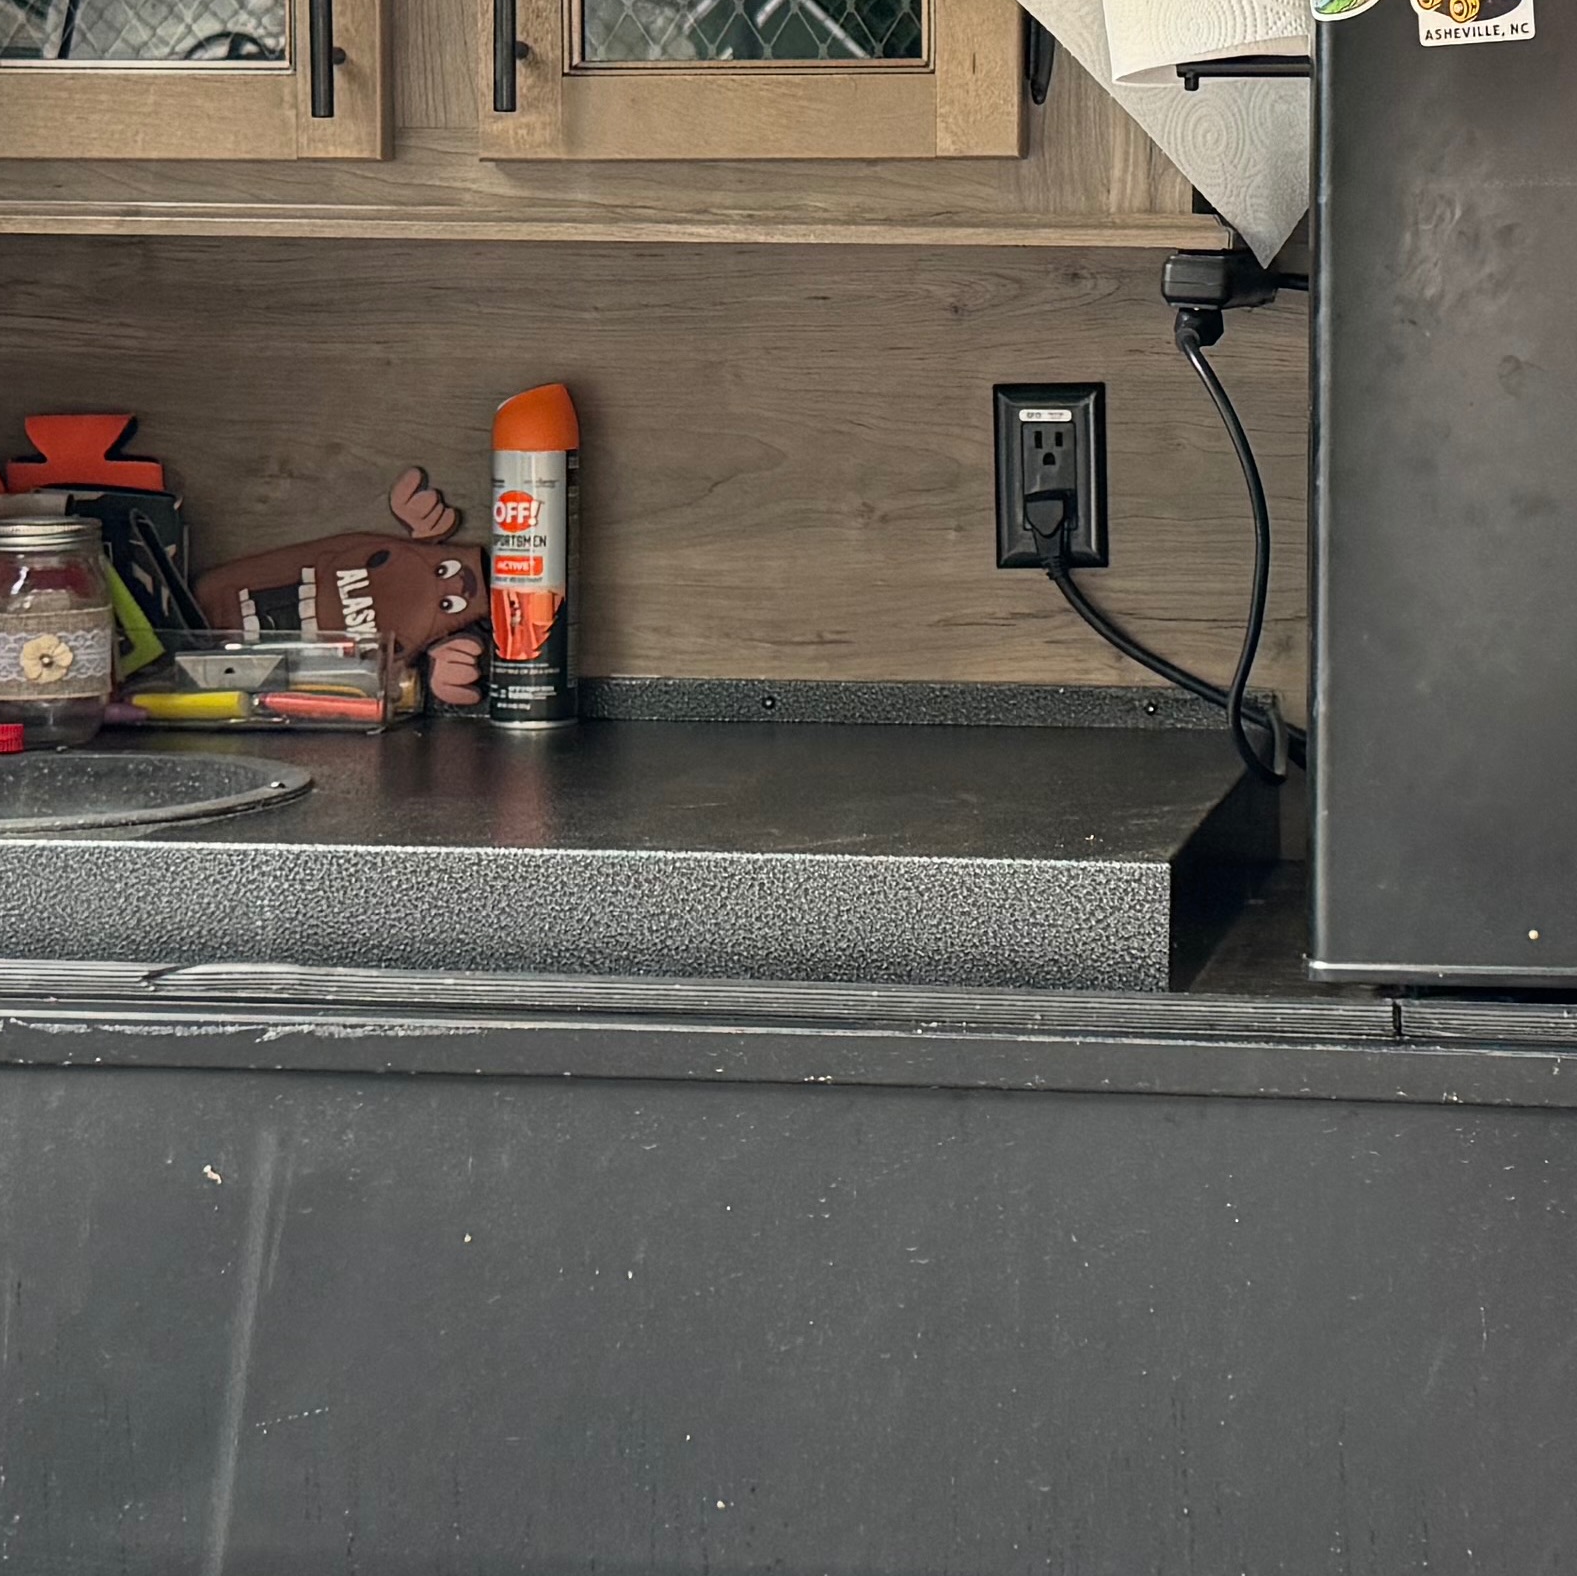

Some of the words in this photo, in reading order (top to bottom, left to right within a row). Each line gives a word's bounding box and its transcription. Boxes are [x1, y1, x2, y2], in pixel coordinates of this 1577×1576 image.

[1425, 25, 1506, 41] ASHEVILLE,
[1510, 23, 1531, 36] NC
[493, 499, 543, 526] OFF!
